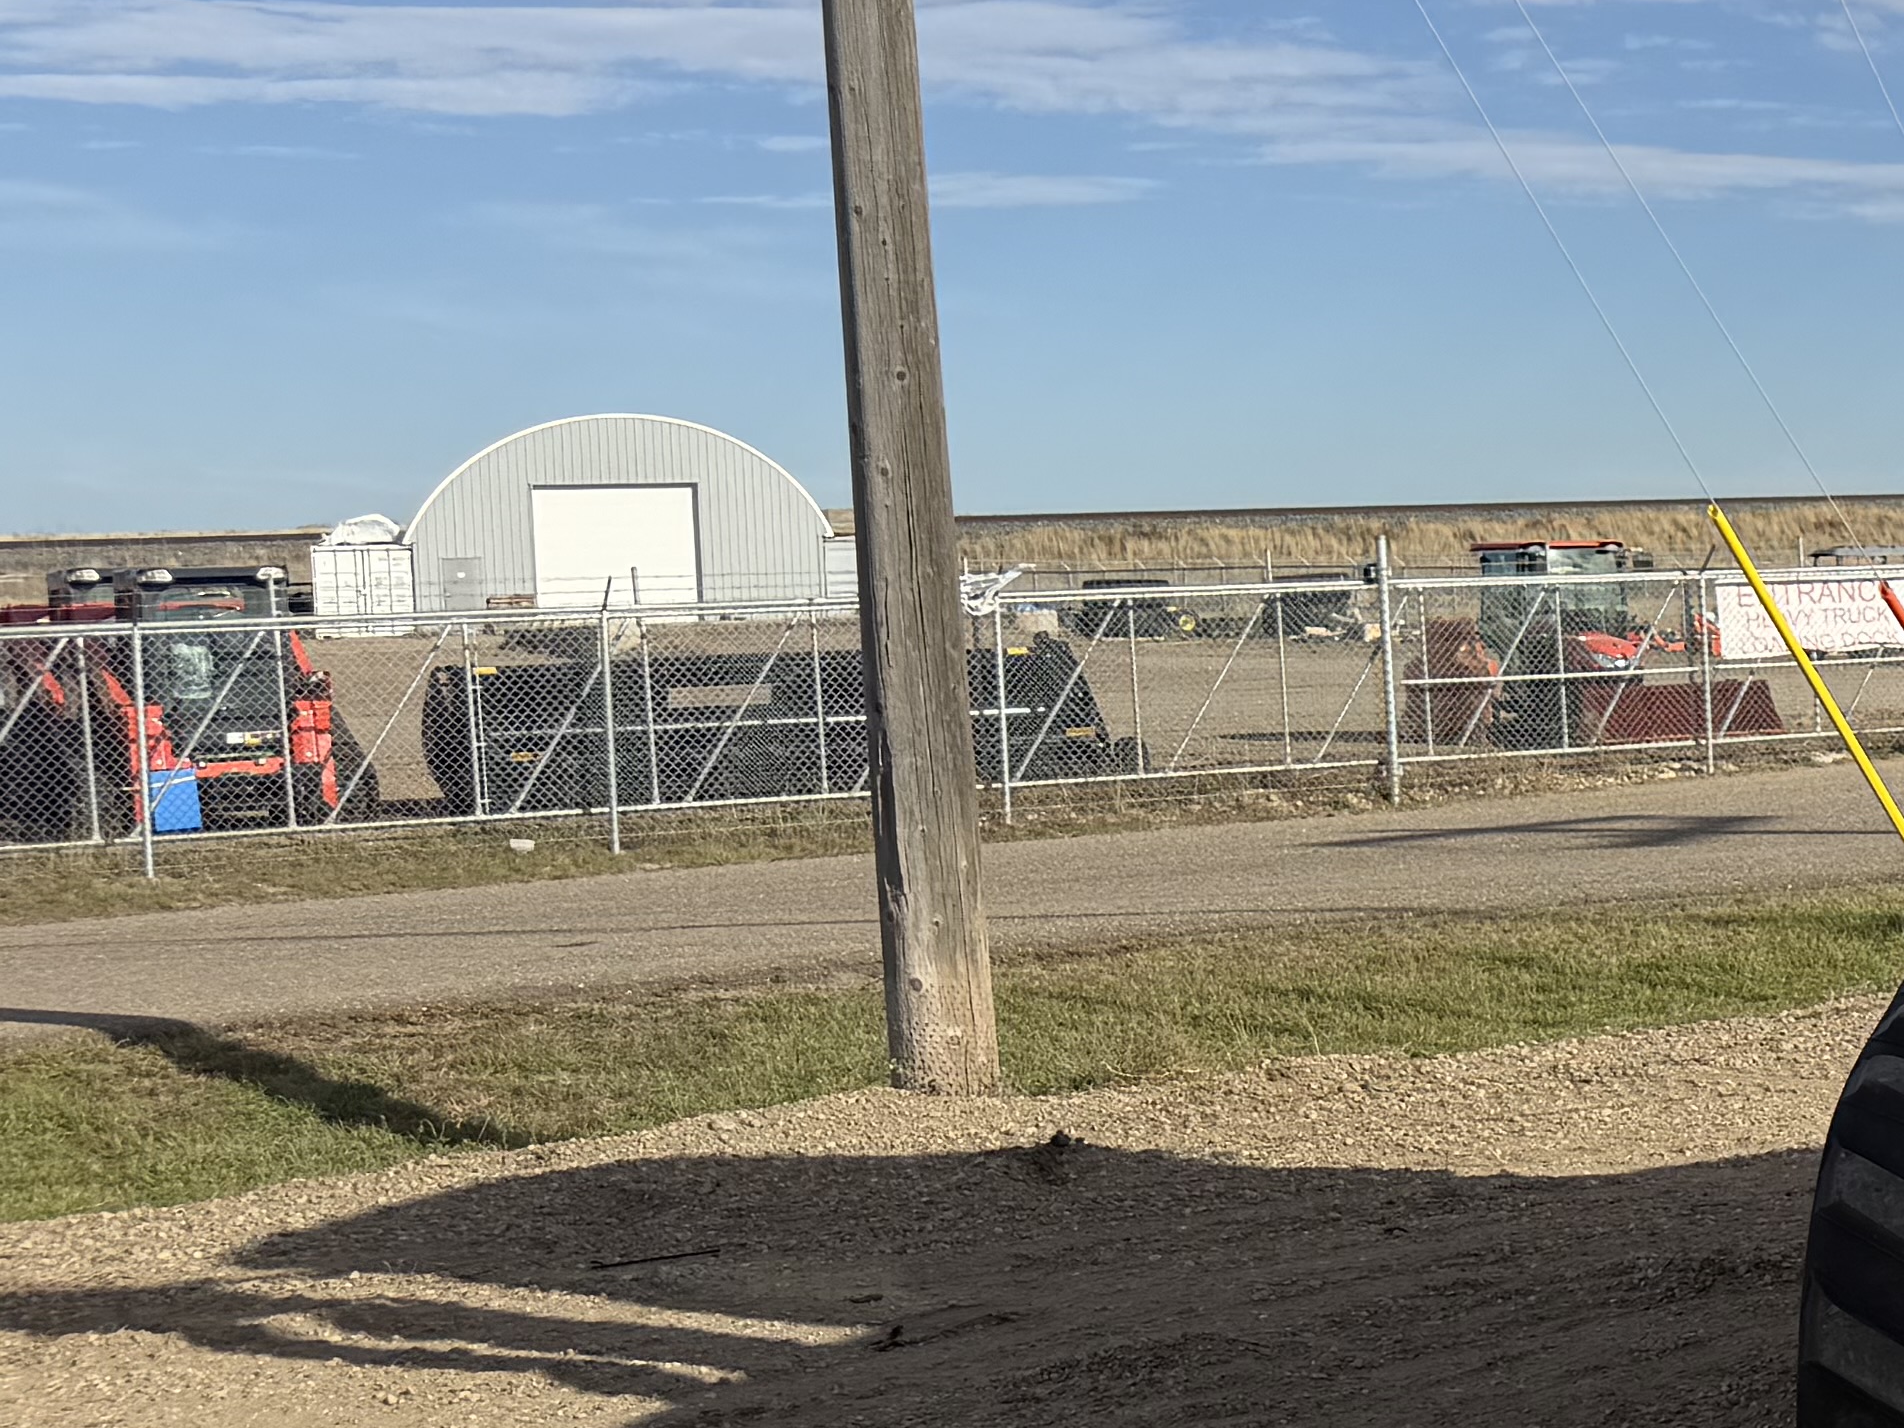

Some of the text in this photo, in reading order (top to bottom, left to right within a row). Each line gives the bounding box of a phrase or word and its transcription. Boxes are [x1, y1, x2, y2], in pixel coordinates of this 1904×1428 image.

[1737, 580, 1880, 607] ETRANC
[1746, 605, 1891, 629] HEVY TRUCK
[1741, 631, 1835, 653] LOAING
